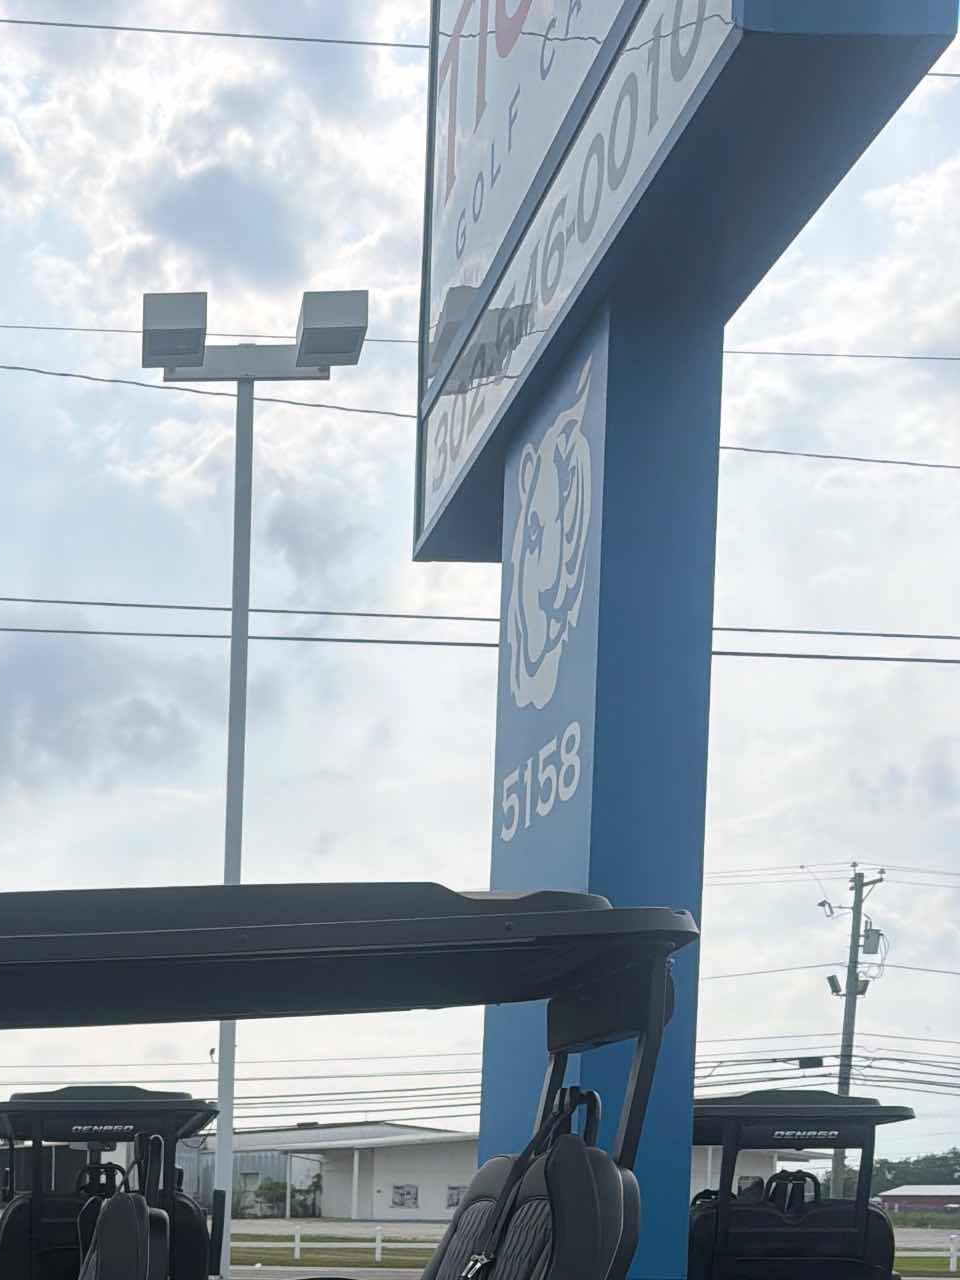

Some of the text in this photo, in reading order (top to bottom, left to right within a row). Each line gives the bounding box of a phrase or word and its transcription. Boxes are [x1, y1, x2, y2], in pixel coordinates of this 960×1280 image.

[455, 83, 520, 260] GOLF
[500, 721, 581, 842] 5158
[773, 1130, 840, 1139] DENAGO
